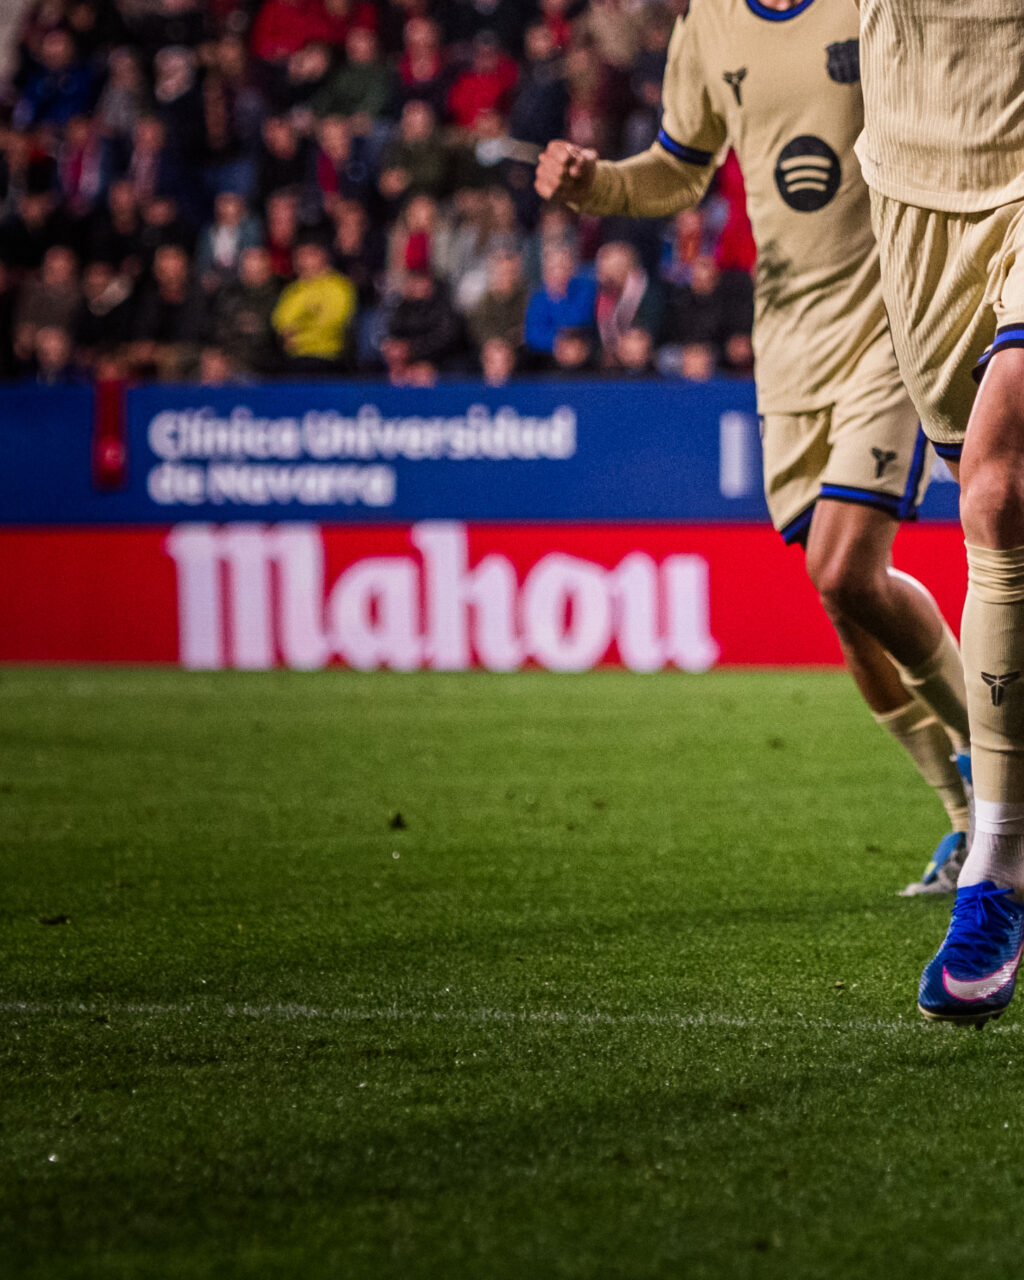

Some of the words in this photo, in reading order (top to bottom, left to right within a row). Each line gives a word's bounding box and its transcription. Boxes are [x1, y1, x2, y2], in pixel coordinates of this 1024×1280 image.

[302, 404, 577, 460] Universidad
[149, 463, 206, 506] de
[207, 462, 397, 507] Navarra
[168, 520, 719, 672] Mahou
